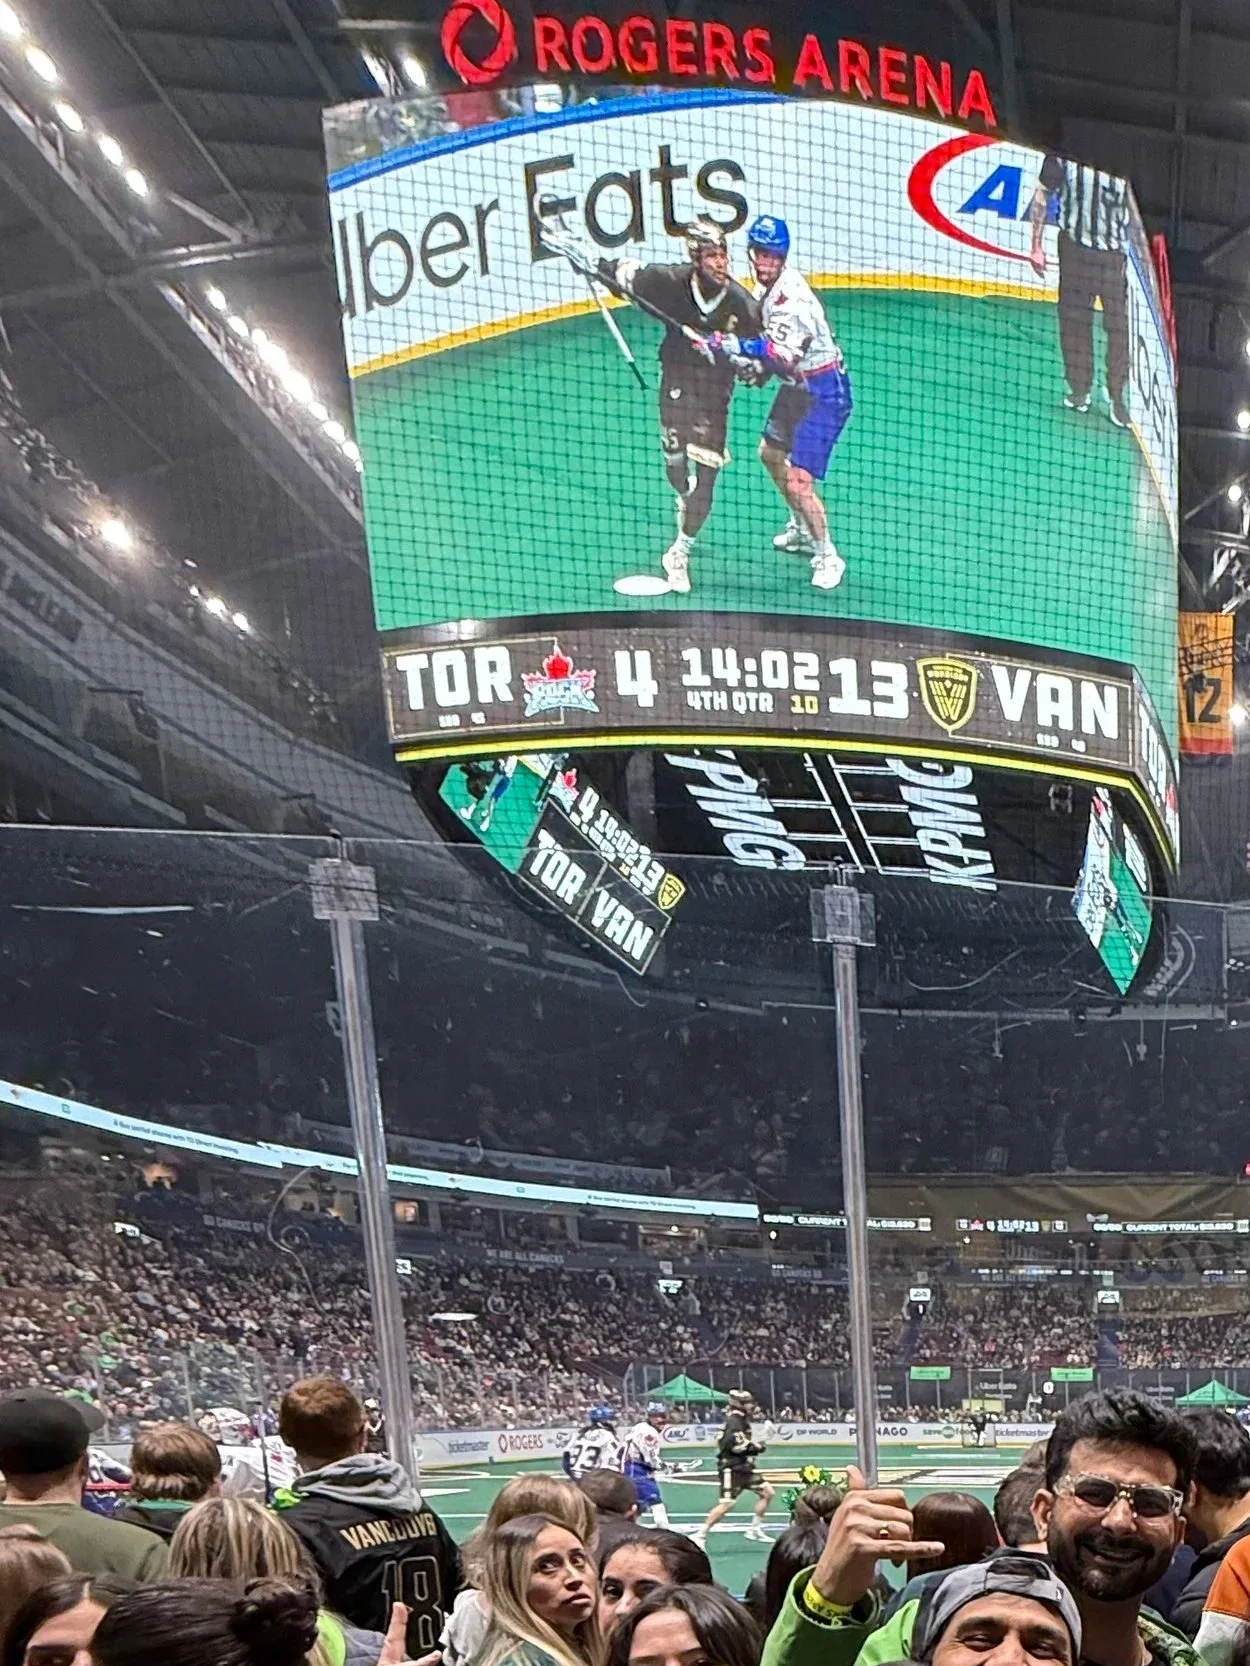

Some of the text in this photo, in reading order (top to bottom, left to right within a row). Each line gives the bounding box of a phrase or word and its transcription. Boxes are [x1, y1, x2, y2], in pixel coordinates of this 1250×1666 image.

[533, 15, 998, 128] ROGERS ARENA
[523, 144, 749, 263] Eats
[396, 646, 514, 711] TOR
[614, 649, 659, 708] 4
[681, 647, 821, 691] 14:02
[828, 656, 910, 719] 13
[1185, 676, 1222, 723] 12
[686, 690, 774, 715] 4TH QTR
[790, 695, 819, 715] 10
[990, 663, 1120, 740] VAN
[530, 827, 587, 906] TOR
[591, 889, 654, 961] VAN
[509, 1434, 544, 1451] ROGERS
[849, 1426, 909, 1437] PNAGO
[381, 1555, 445, 1653] 18
